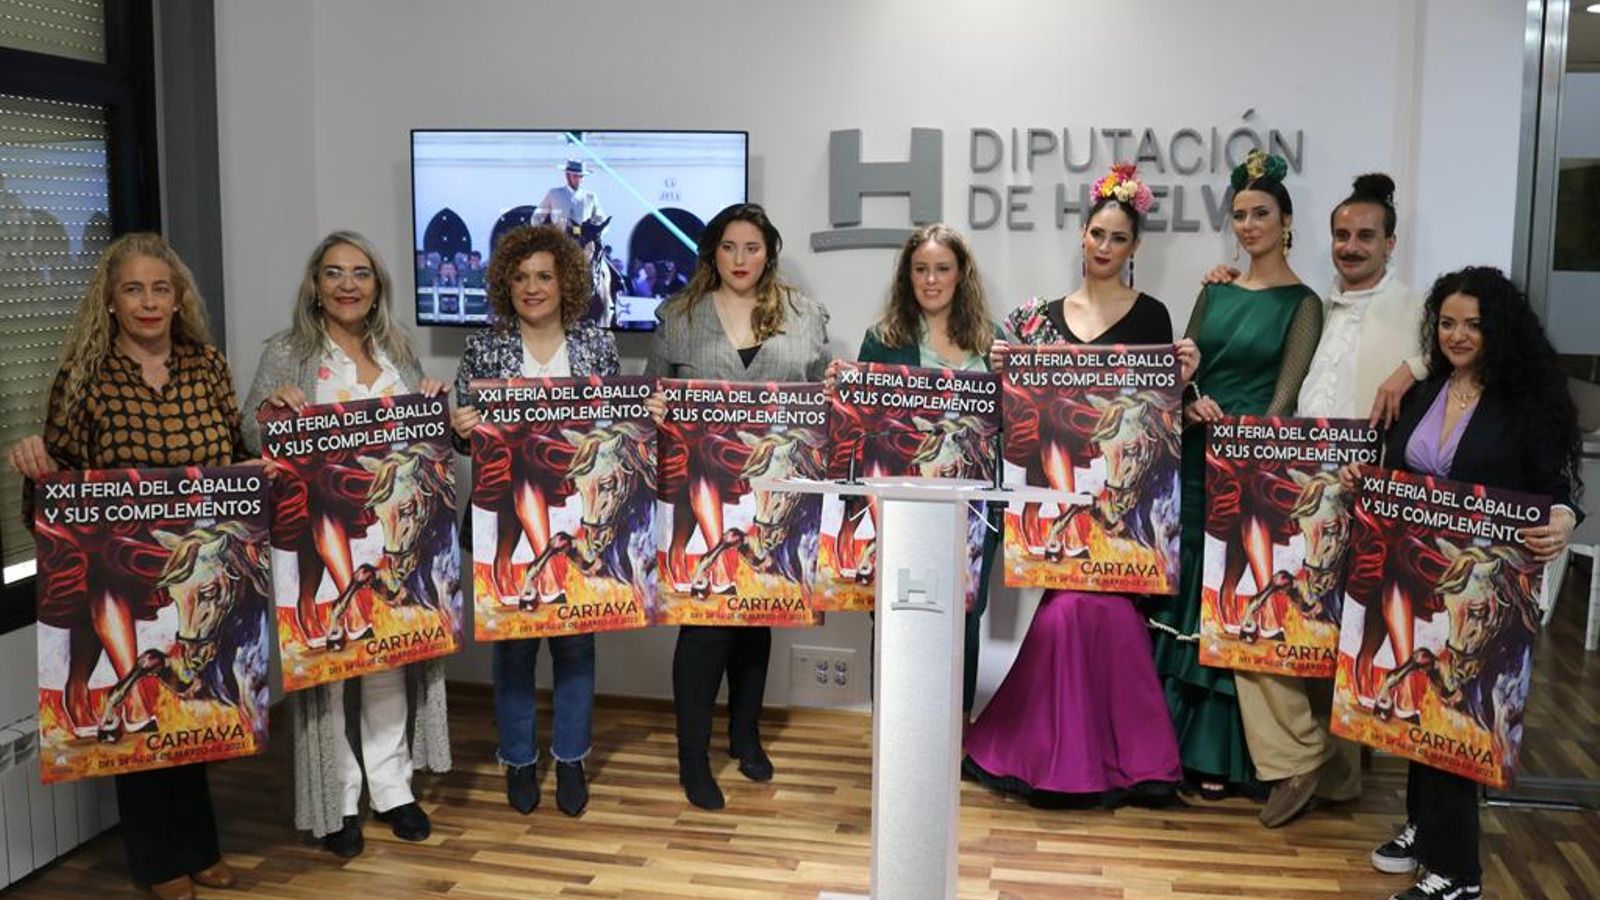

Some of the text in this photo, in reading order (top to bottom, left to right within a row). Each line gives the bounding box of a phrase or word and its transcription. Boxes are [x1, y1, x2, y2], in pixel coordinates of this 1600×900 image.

[970, 108, 1304, 174] DIPUTACIÓN
[968, 183, 1234, 232] DE HELV
[1009, 353, 1174, 367] XXI FERIA DEL CABALLO
[841, 370, 996, 394] XXI FERIA DEL CABALLO
[1009, 371, 1175, 387] Y SUS COMPLEMENTOS
[478, 385, 650, 402] XXI FERIA DEL CABALLO
[685, 389, 724, 402] FERIA
[729, 390, 756, 404] DEL
[760, 391, 825, 406] CABALLO
[839, 390, 995, 413] Y SUS COMPLEMENTOS
[268, 402, 443, 435] XXI FERIA DEL CABALLO
[480, 409, 489, 423] Y
[493, 408, 520, 422] SUS
[525, 405, 650, 421] COMPLEMENTOS
[673, 408, 699, 422] SUS
[702, 407, 825, 425] COMPLEMENTOS
[270, 422, 445, 458] Y SUS COMPLEMENTOS
[1213, 425, 1378, 443] XXI FERIA DEL CABALLO
[1212, 445, 1377, 463] Y SUS COMPLEMENTOS
[46, 477, 261, 500] XXI FERIA DEL CABALLO
[1363, 477, 1541, 521] XXI FERIA DEL CABALLO
[45, 499, 261, 525] Y SUS COMPLEMENTOS
[1361, 498, 1525, 543] Y SUS COMPLEMENTO
[1081, 561, 1160, 578] CARTAYA
[557, 600, 638, 620] CARTAYA
[728, 597, 805, 611] CARTAYA
[366, 627, 446, 655] CARTAYA
[1276, 644, 1338, 661] CARTA
[146, 723, 245, 750] CARTAYA
[1408, 727, 1495, 767] CARTAYA
